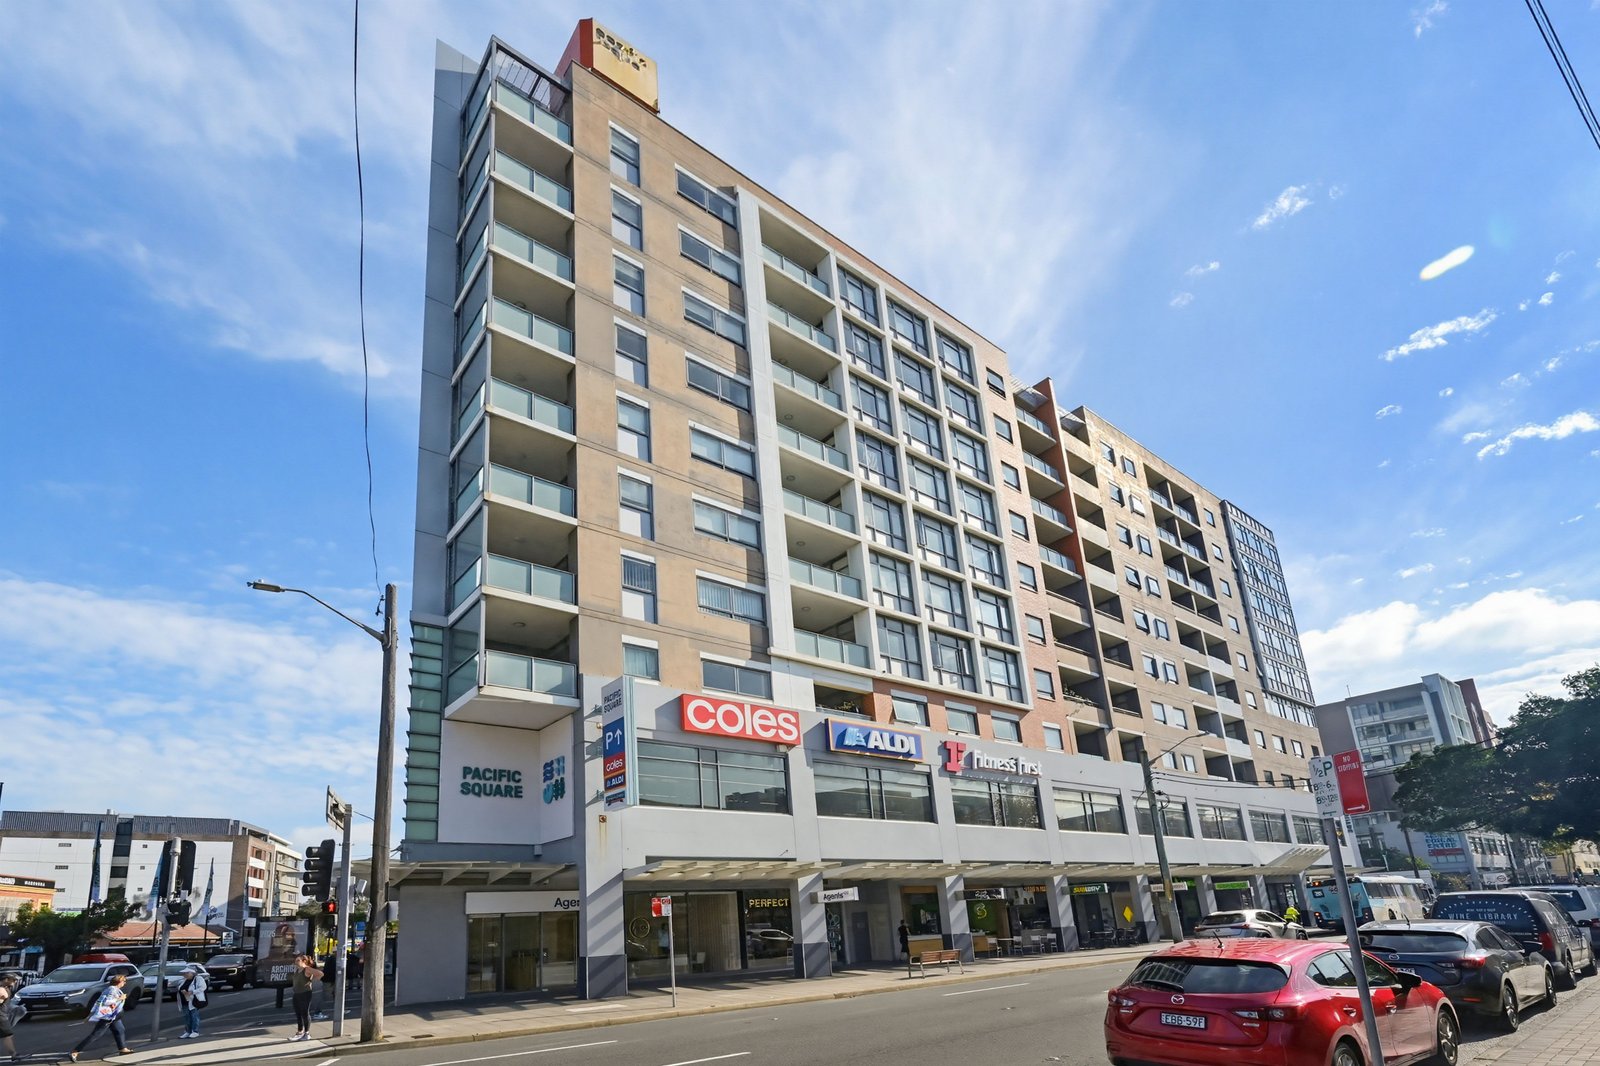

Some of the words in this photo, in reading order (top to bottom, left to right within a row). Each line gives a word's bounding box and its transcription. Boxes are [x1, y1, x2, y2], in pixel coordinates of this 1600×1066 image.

[687, 699, 799, 741] coles
[606, 731, 614, 750] P
[868, 734, 916, 755] ALDI
[606, 759, 624, 772] coles
[972, 749, 1017, 773] Fitness
[1018, 756, 1043, 777] First
[462, 766, 522, 783] PACIFIC
[612, 776, 624, 786] ALDI
[460, 781, 524, 799] SQUARE
[748, 898, 789, 908] PERFECT
[1448, 912, 1470, 920] WINE
[1478, 912, 1518, 921] LIBRARY
[270, 972, 288, 982] PRIZE
